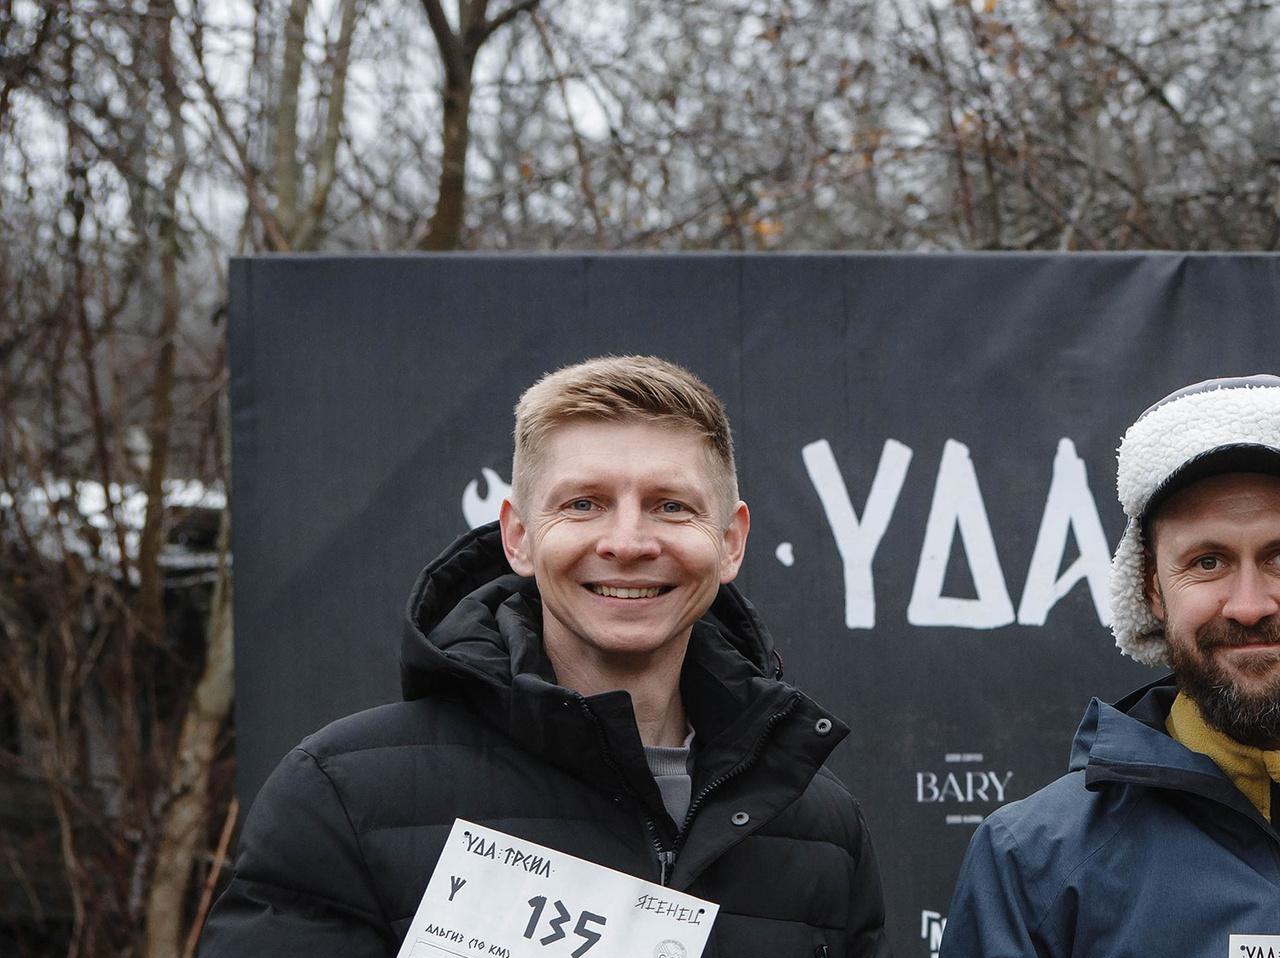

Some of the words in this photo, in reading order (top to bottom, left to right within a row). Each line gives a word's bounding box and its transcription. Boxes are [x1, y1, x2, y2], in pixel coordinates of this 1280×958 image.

[801, 437, 1113, 629] УДА
[916, 770, 1013, 802] BARY
[425, 923, 465, 944] АЛЬГИЗ
